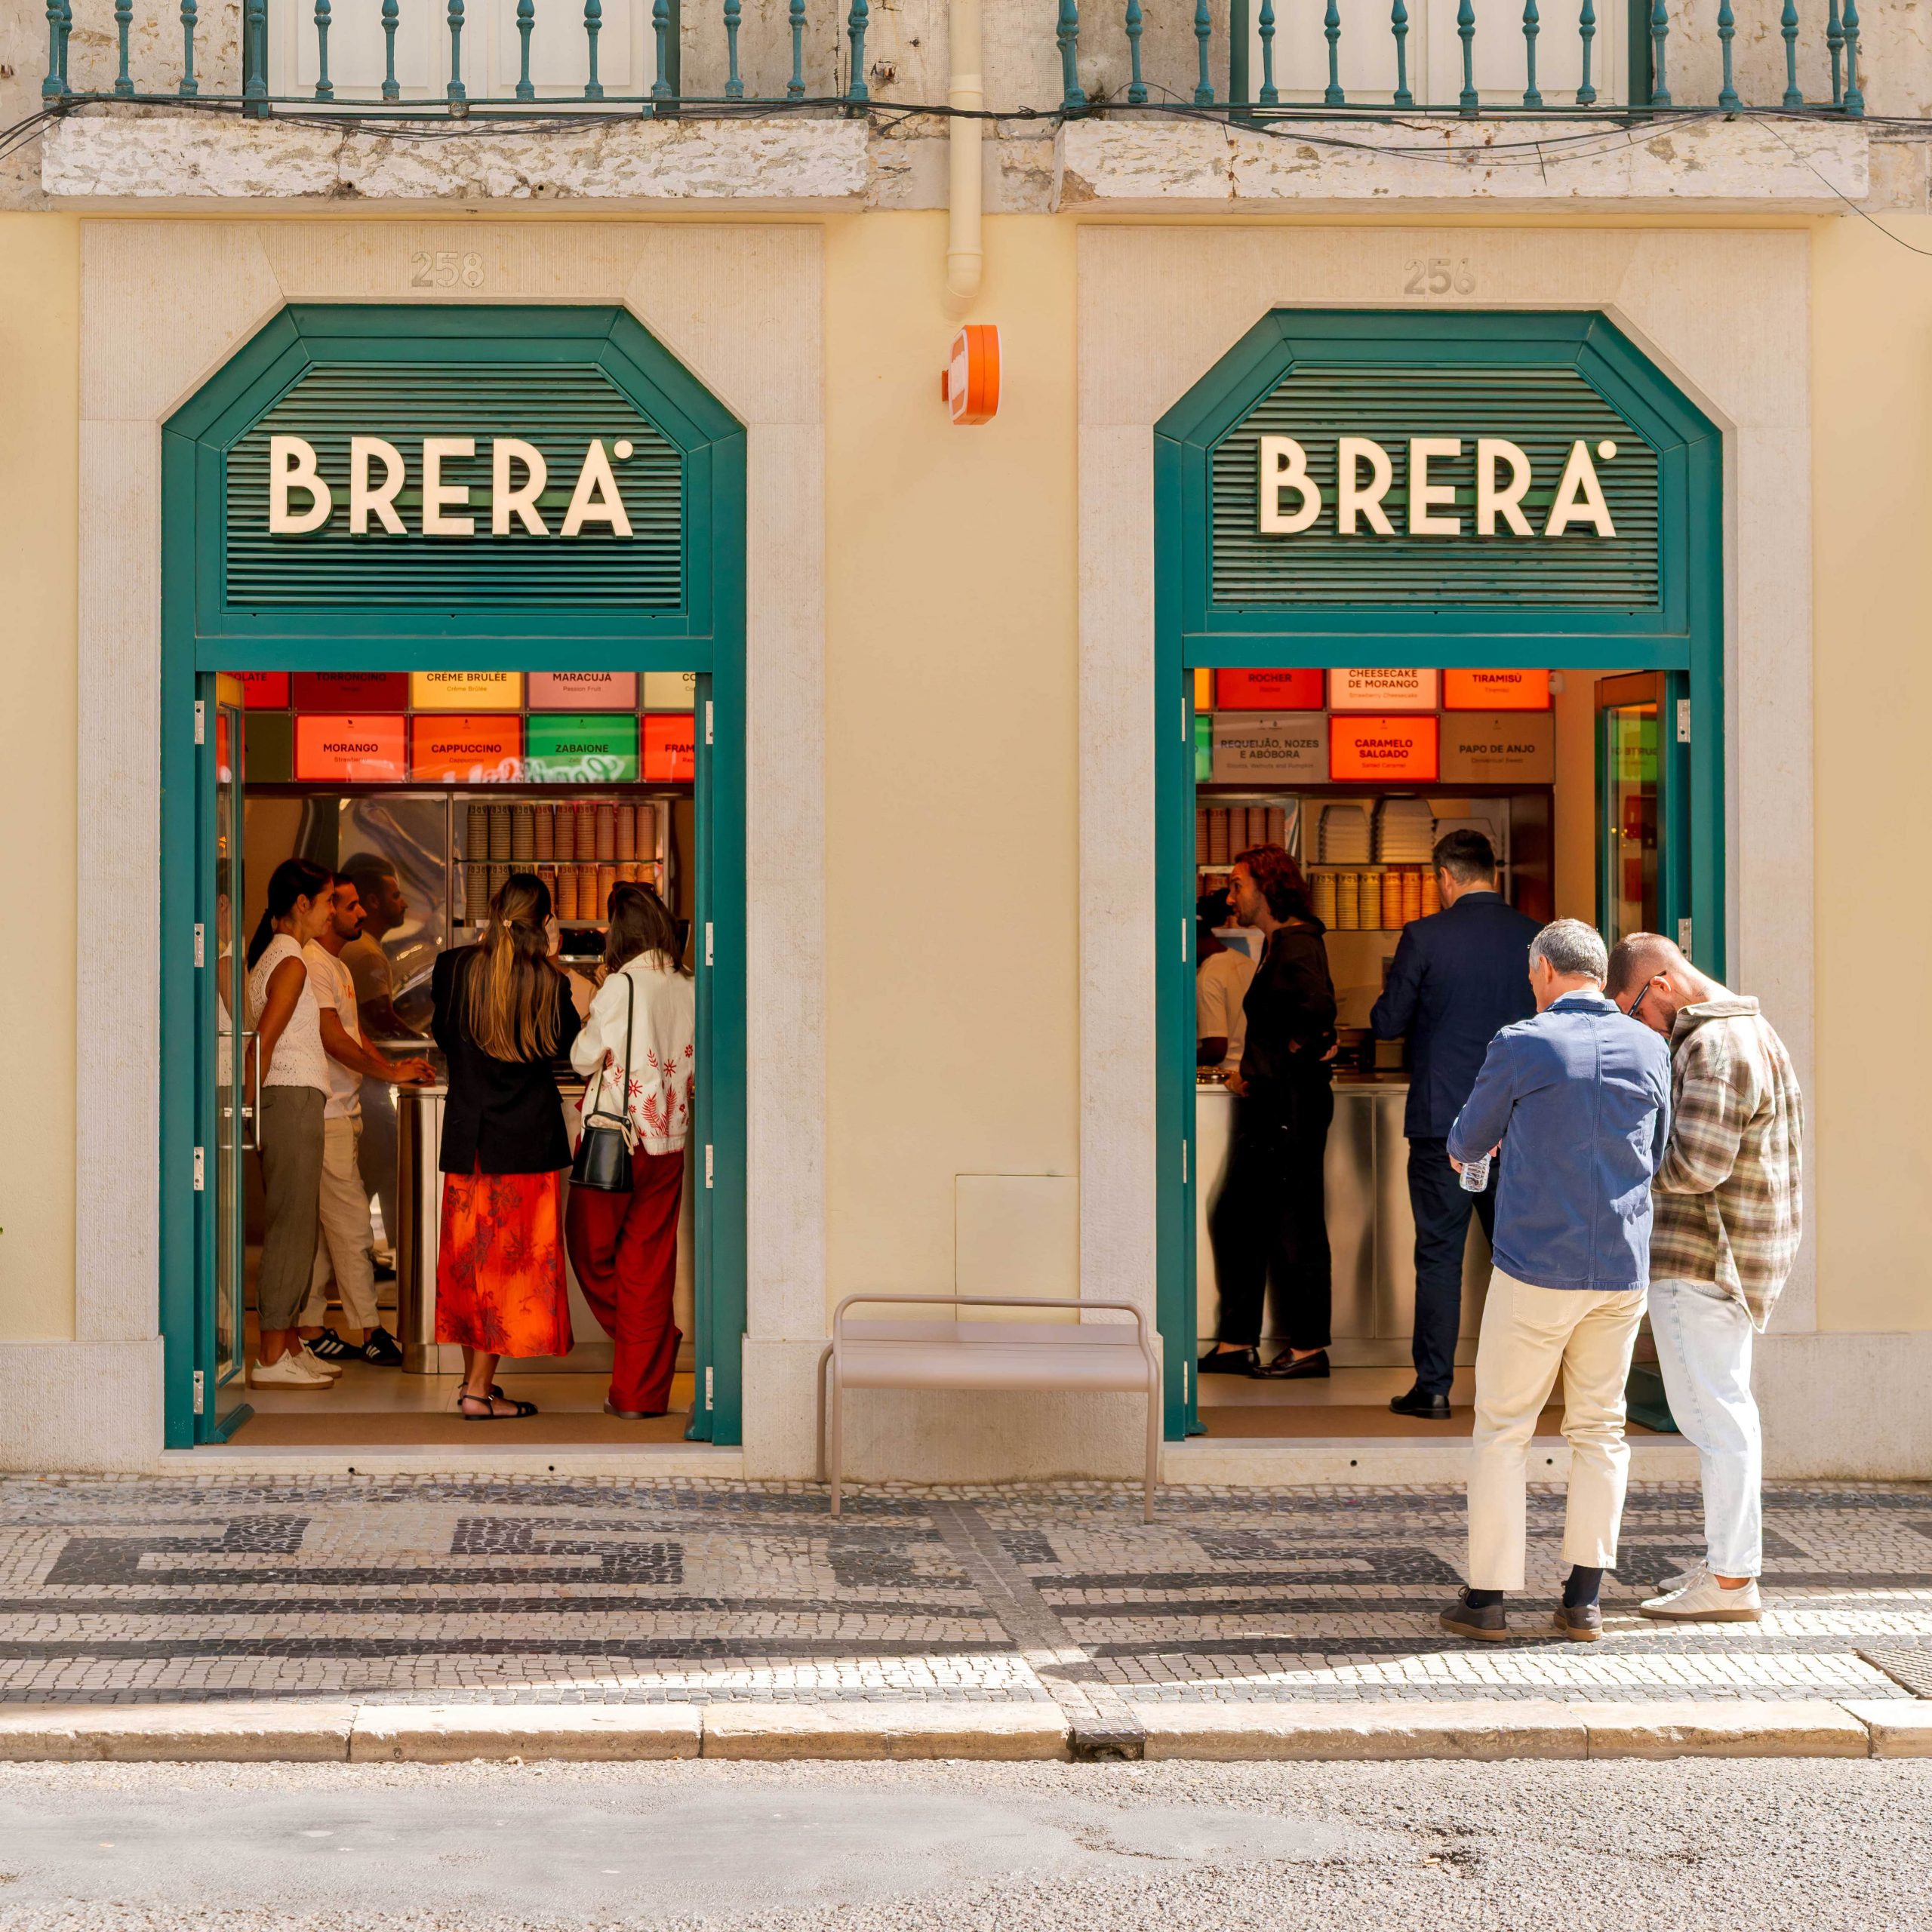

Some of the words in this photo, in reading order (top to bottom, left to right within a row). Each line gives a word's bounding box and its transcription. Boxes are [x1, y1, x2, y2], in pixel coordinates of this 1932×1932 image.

[411, 251, 485, 288] 258
[1404, 258, 1475, 295] 256
[1248, 673, 1292, 682] ROCHER
[323, 743, 379, 752] MORANGO
[555, 744, 609, 752] ZABAIONE
[665, 744, 694, 752] FRAM
[1284, 740, 1319, 748] NOZES
[1355, 739, 1413, 748] CARAMELO
[431, 744, 502, 753] CAPPUCCINO
[1460, 745, 1487, 753] PAPO
[1491, 745, 1503, 753] DE
[1506, 745, 1535, 753] ANJO
[1249, 749, 1300, 758] ABÓBORA
[1359, 749, 1409, 758] SALGADO
